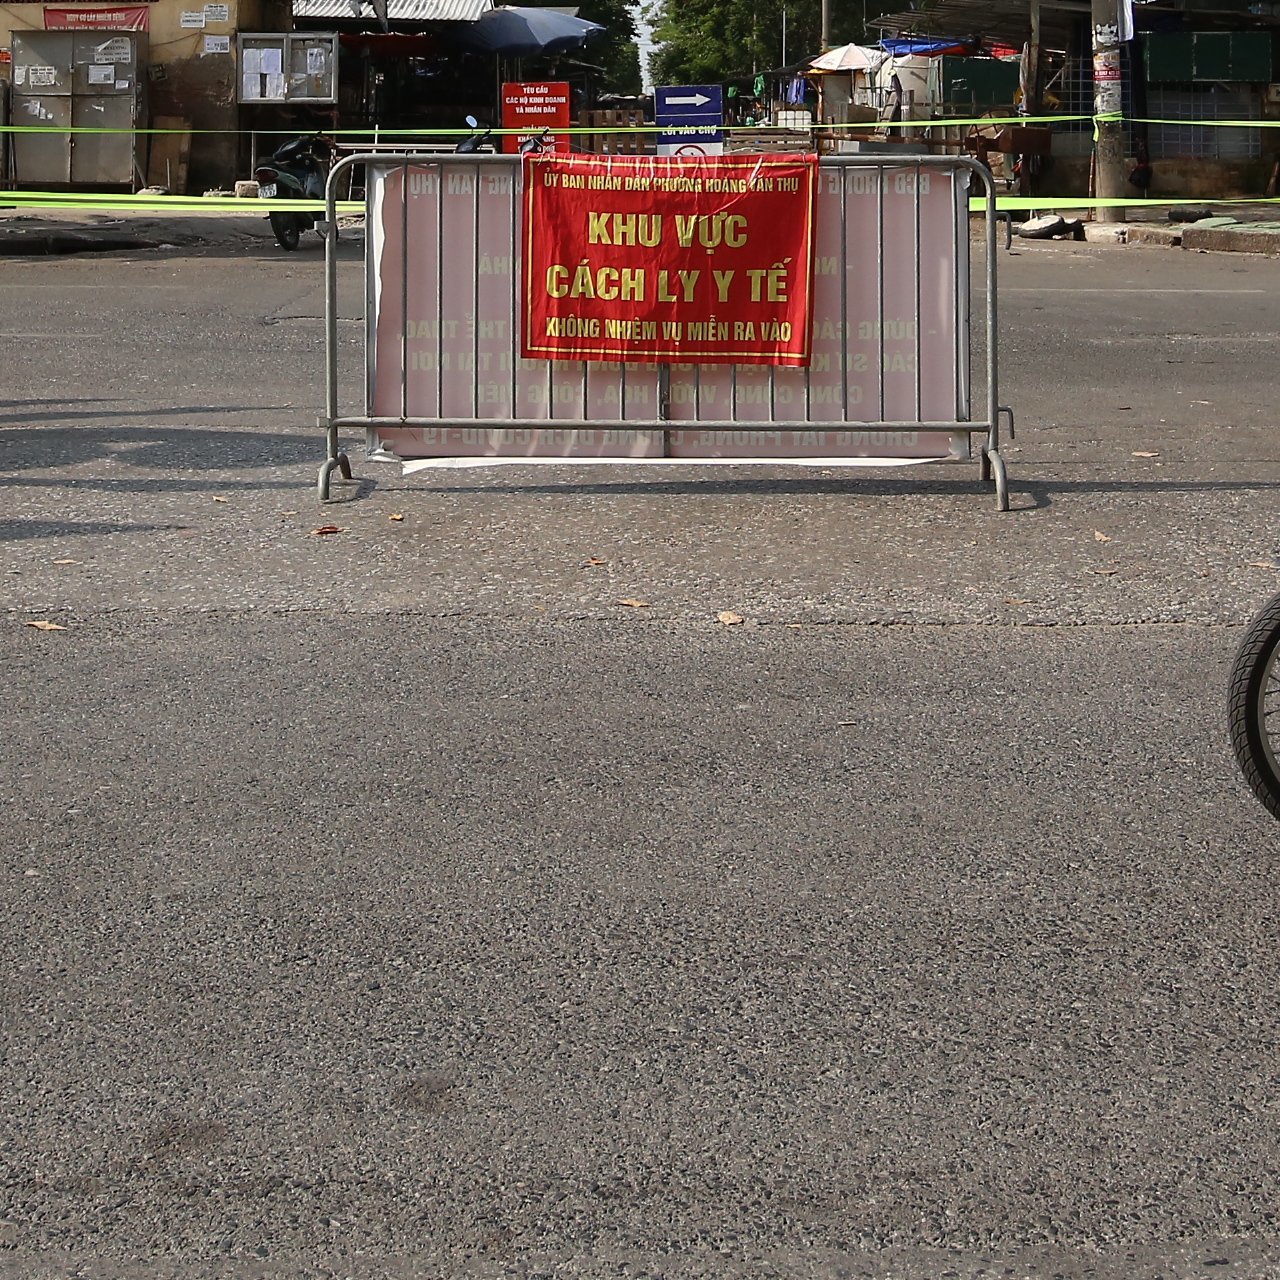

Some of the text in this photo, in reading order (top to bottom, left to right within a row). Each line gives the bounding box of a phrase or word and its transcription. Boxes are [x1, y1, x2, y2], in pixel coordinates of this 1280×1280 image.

[544, 168, 559, 188] ỦY
[562, 174, 585, 190] BAN
[588, 173, 622, 191] NHÂN
[624, 174, 650, 191] DÂN
[653, 174, 702, 193] PHƯỜNG
[705, 175, 747, 193] HOÀNG
[777, 177, 799, 195] THỤ
[588, 211, 748, 255] KHU VỰC
[546, 258, 645, 302] CÁCH
[658, 269, 700, 303] LY
[713, 269, 737, 303] Y
[746, 257, 792, 302] TẾ
[545, 314, 792, 345] KHÔNG NHIỆM VỤ MIỄN RA VÀO
